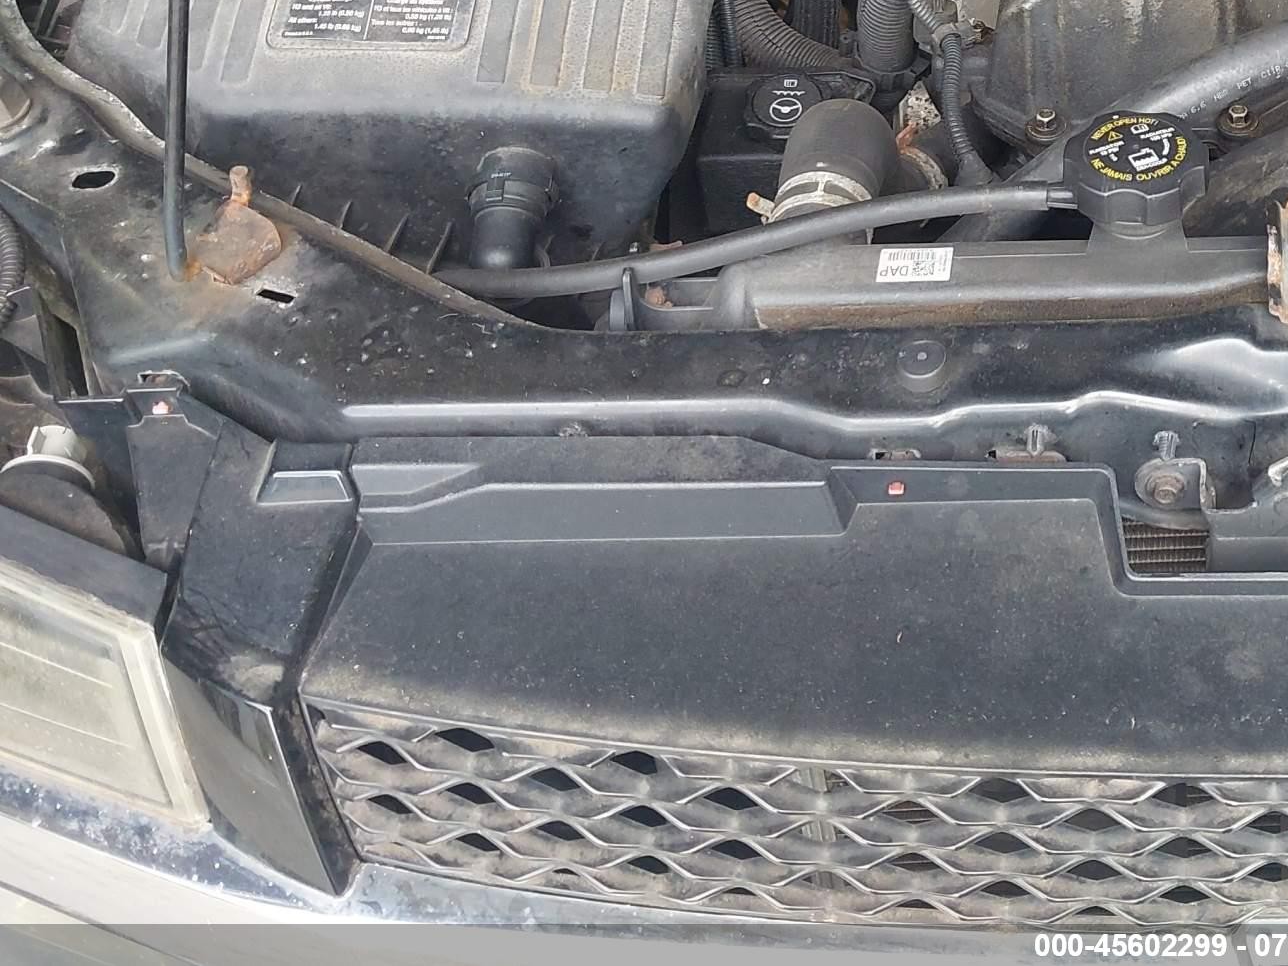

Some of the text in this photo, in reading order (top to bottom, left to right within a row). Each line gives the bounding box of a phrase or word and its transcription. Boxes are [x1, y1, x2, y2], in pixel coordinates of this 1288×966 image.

[1091, 117, 1160, 141] NEVER OPEN HOT!
[1090, 158, 1103, 170] NE
[1100, 165, 1133, 181] JAMAIS
[1136, 164, 1174, 181] OUVRIR
